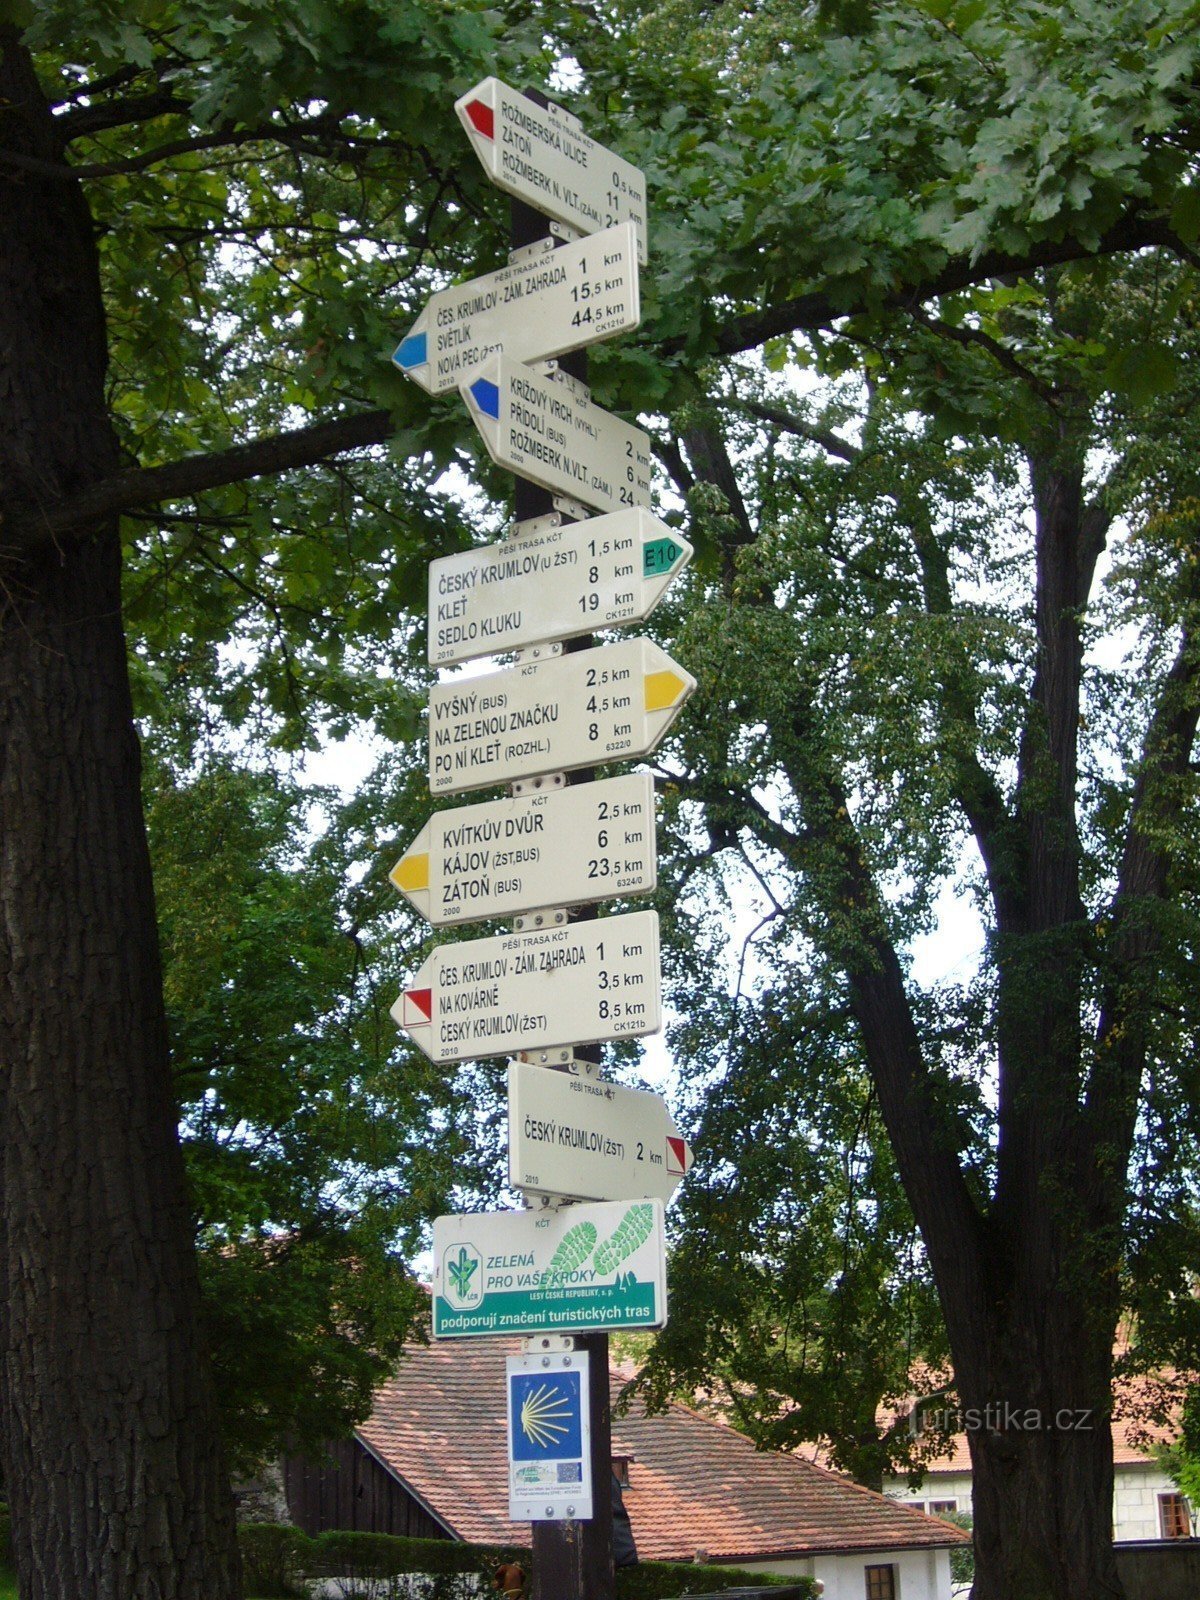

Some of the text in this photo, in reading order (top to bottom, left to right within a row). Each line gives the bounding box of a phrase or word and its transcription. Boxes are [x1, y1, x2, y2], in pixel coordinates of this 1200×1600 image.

[562, 124, 581, 141] TRASA
[563, 136, 588, 168] ULICE
[628, 185, 641, 201] km
[552, 180, 562, 200] N.
[607, 191, 619, 211] 11
[629, 209, 642, 225] km
[513, 261, 538, 276] TRASA
[436, 307, 454, 328] ČES.
[457, 291, 498, 321] KRUMLOV
[504, 281, 524, 303] ZÁM.
[525, 266, 567, 296] ZAHRADA
[578, 257, 587, 274] 1
[603, 252, 622, 265] km
[570, 281, 601, 303] 15,5
[605, 276, 624, 290] km
[437, 349, 461, 376] NOVÁ
[462, 347, 479, 368] PEC
[571, 306, 602, 328] 44,5
[605, 303, 624, 316] km
[549, 399, 573, 425] VRCH
[625, 440, 633, 458] 2
[636, 450, 649, 467] km
[546, 426, 567, 449] (BUS)
[627, 466, 634, 483] 6
[637, 476, 649, 491] km
[619, 486, 634, 507] 24
[518, 537, 545, 550] TRASA
[644, 544, 676, 568] E10
[438, 567, 478, 595] ČESKÝ
[480, 554, 541, 585] KRUMLOV
[614, 537, 633, 550] km
[437, 564, 634, 621] KLEŤ 8 km
[437, 591, 634, 647] SEDLO KLUKU 19 km
[437, 649, 455, 660] 2010
[521, 665, 538, 677] KČT
[434, 691, 478, 720] VYŠNÝ
[479, 693, 508, 714] (BUS)
[611, 667, 630, 681] km
[435, 729, 450, 748] NA
[453, 718, 507, 742] ZELENOU
[509, 703, 559, 732] ZNAČKU
[612, 695, 631, 709] km
[435, 722, 632, 773] PO NÍ KLEŤ (ROZHL.) 8 km
[435, 776, 453, 787] 2000
[531, 796, 548, 807] KČT
[623, 802, 642, 816] km
[443, 849, 490, 876] KÁJOV
[597, 829, 608, 848] 6
[624, 830, 643, 844] km
[442, 858, 643, 903] ZÁTOŇ (BUS) 23,5 km
[442, 876, 643, 917] 2000 6324/0
[522, 935, 550, 948] TRASA
[551, 931, 569, 944] KČT
[439, 964, 460, 988] ČES.
[462, 957, 507, 984] KRUMLOV
[515, 950, 538, 976] ZÁM.
[539, 945, 586, 971] ZAHRADA
[596, 942, 605, 961] 1
[622, 943, 643, 957] km
[439, 995, 453, 1015] NA
[454, 984, 499, 1013] KOVÁRNĚ
[623, 972, 644, 986] km
[440, 1016, 473, 1043] ČESKÝ
[473, 1013, 519, 1040] KRUMLOV
[624, 1002, 645, 1016] km
[440, 1020, 646, 1058] 2010 CK121b
[584, 1086, 603, 1098] TRASA
[524, 1114, 556, 1144] ČESKÝ
[558, 1125, 603, 1153] KRUMLOV
[636, 1142, 644, 1161] 2
[650, 1149, 663, 1165] km
[525, 1174, 539, 1185] 2010
[535, 1219, 551, 1229] KČT
[486, 1251, 535, 1270] ZELENÁ
[487, 1269, 597, 1289] PRO VAŠE KROKY
[529, 1291, 544, 1300] LESY
[545, 1289, 564, 1300] ČESKÉ
[440, 1305, 650, 1330] podporují značení turistických tras
